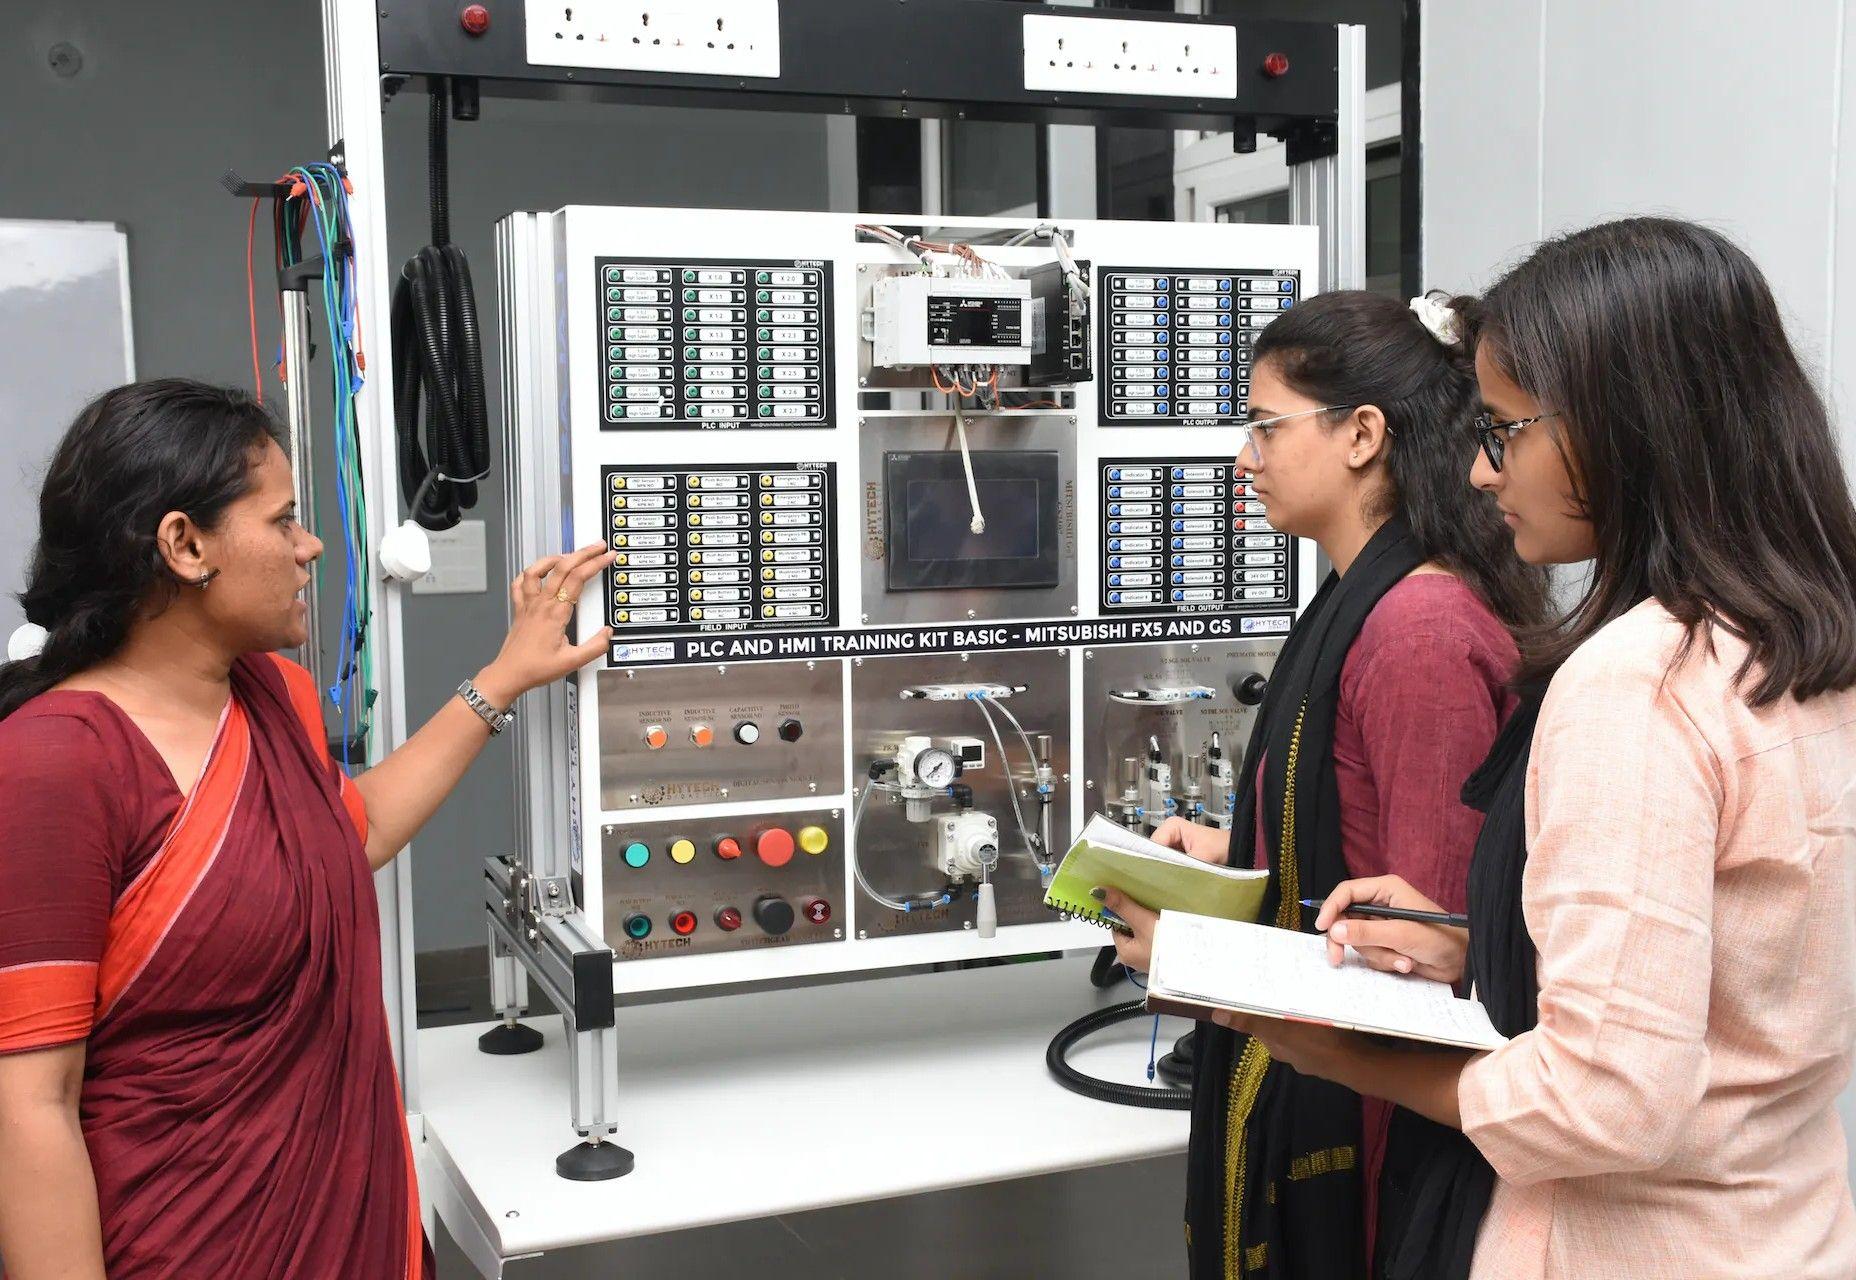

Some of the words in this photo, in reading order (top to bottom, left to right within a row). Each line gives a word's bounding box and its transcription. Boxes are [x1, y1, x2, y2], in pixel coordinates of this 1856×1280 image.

[687, 640, 724, 658] PLC
[729, 639, 773, 656] AND
[778, 637, 816, 654] HMI
[821, 633, 915, 652] TRAINING
[920, 631, 949, 648] KIT
[954, 628, 1008, 646] BASIC
[1026, 624, 1127, 642] MITSUBISHI
[1132, 622, 1162, 638] FX5
[1166, 620, 1205, 636] AND
[645, 937, 690, 950] HYTECH
